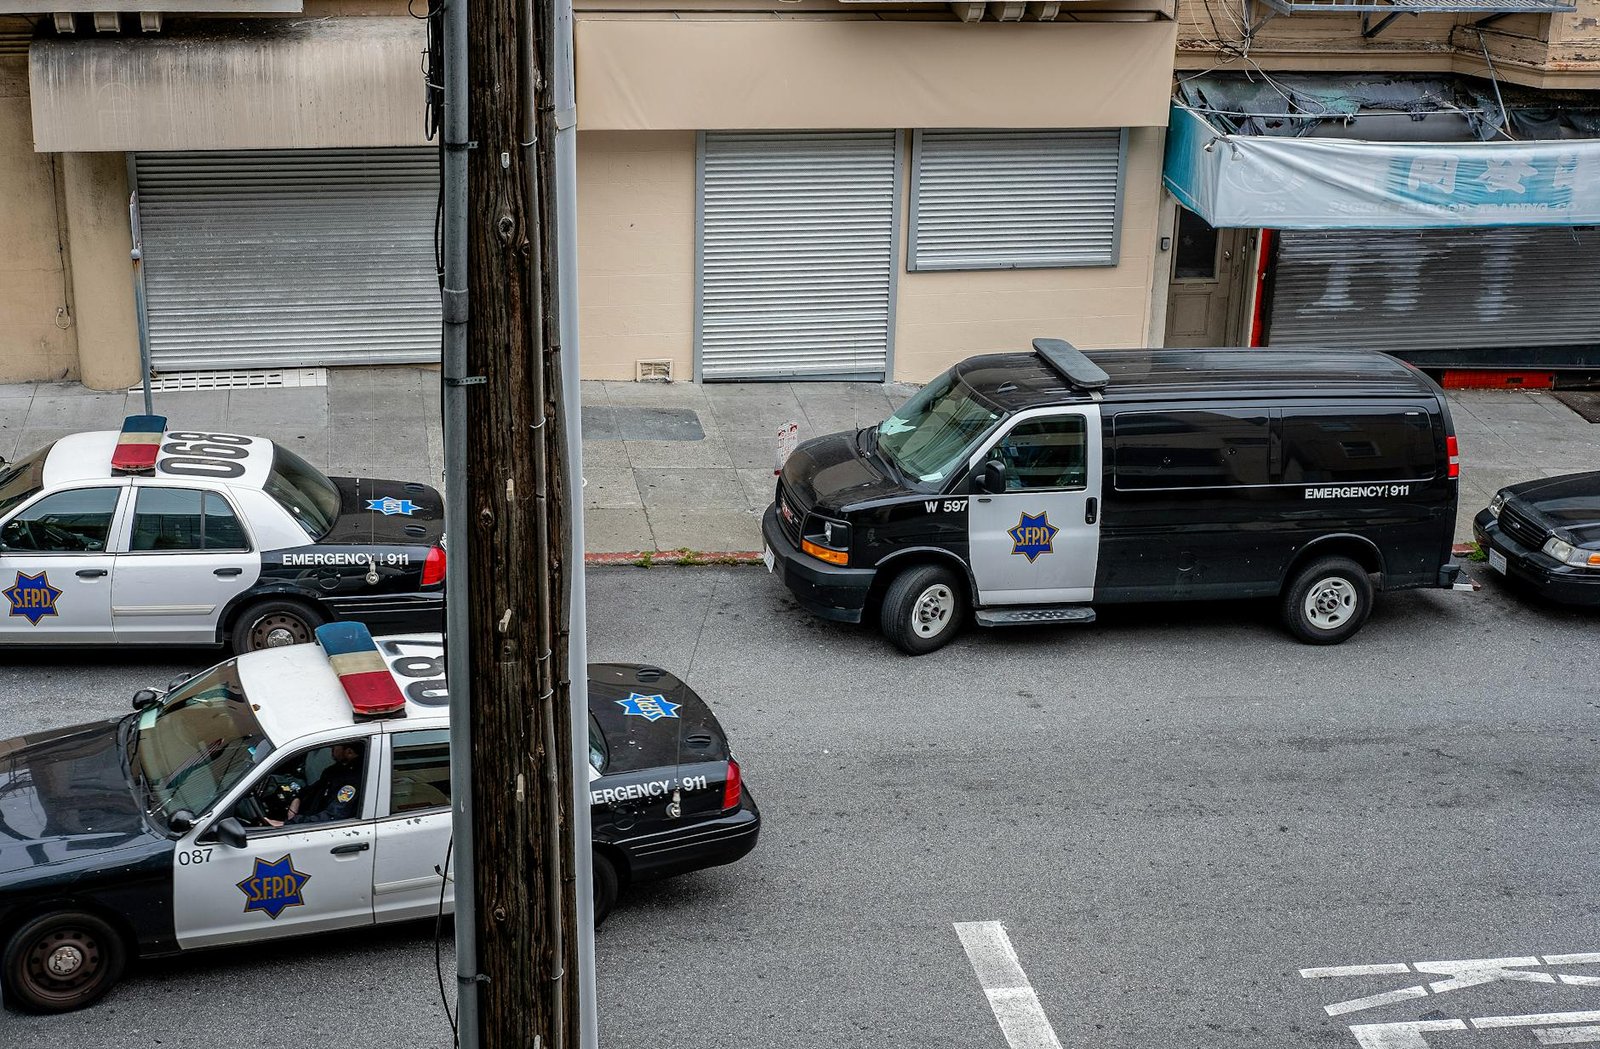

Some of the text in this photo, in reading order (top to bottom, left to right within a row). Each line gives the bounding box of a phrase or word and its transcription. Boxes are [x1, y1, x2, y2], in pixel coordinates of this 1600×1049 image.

[156, 431, 253, 478] 068
[1304, 485, 1409, 499] EMERGENCY 911
[925, 500, 968, 513] W 597
[282, 553, 409, 566] EMERGENCY 911
[590, 775, 707, 805] ERGENCY 911
[178, 848, 213, 866] 087
